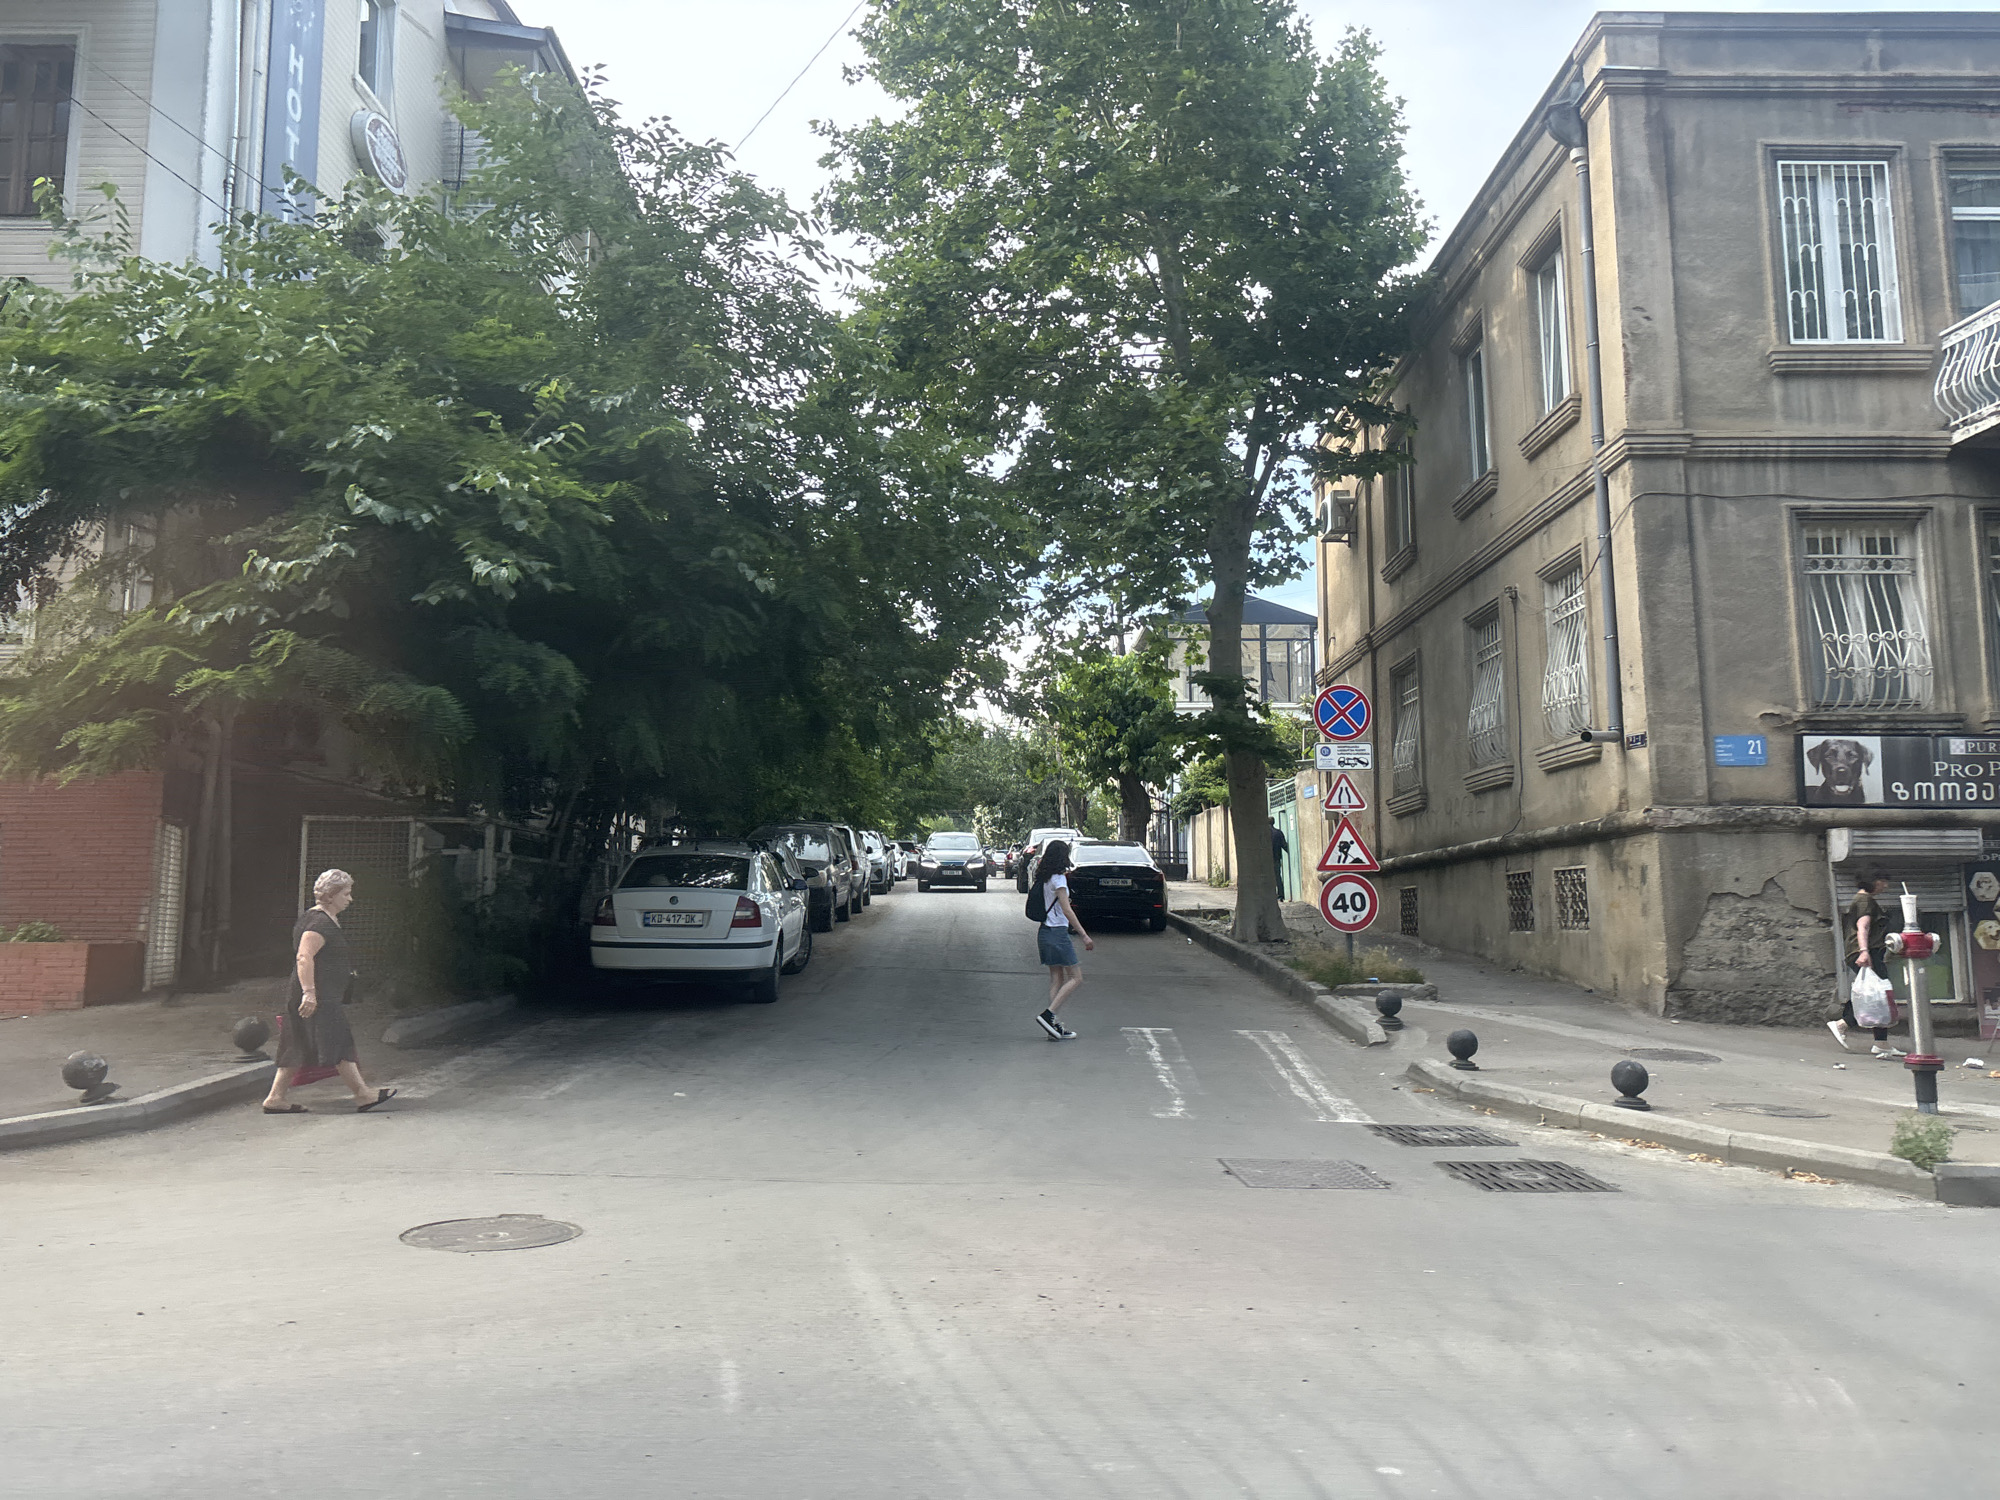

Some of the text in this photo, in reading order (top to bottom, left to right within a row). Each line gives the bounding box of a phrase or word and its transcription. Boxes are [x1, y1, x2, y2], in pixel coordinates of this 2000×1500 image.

[1747, 740, 1762, 755] 21
[1967, 741, 2000, 752] PUR
[1934, 761, 1983, 778] PRO
[1892, 782, 2000, 801] ზოომა
[1332, 892, 1366, 913] 40
[651, 914, 696, 924] KD-417-DK
